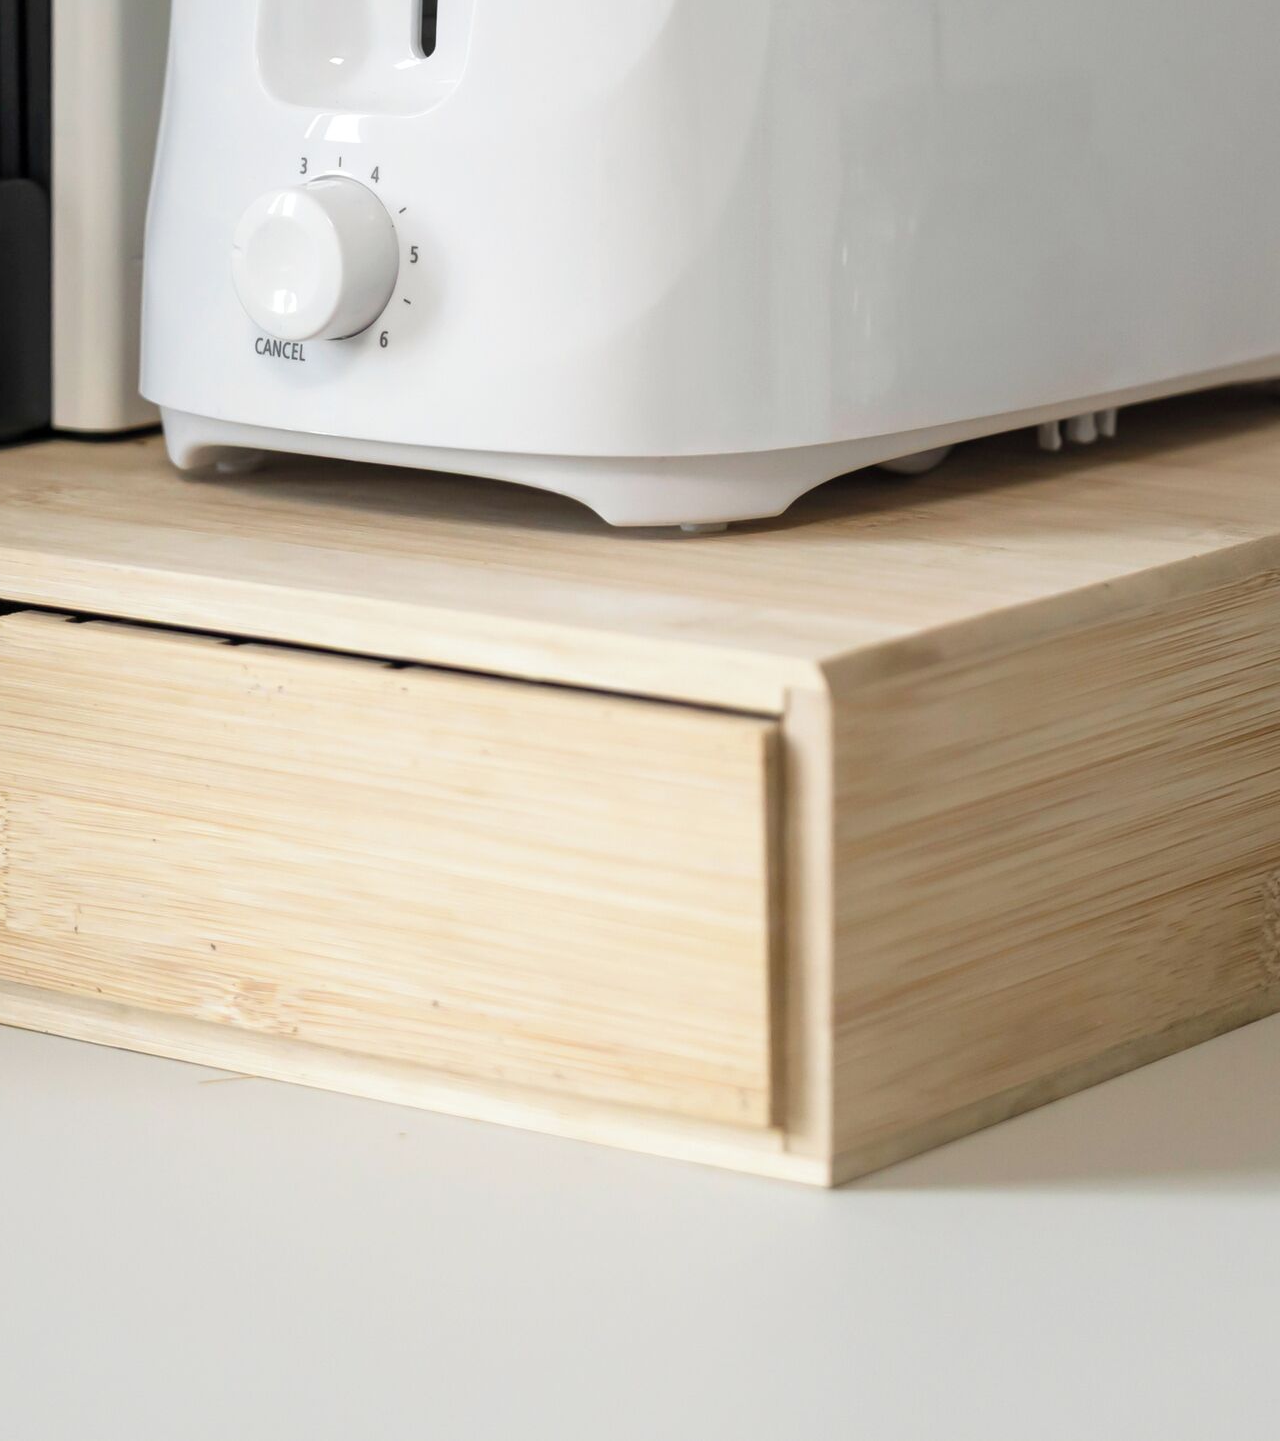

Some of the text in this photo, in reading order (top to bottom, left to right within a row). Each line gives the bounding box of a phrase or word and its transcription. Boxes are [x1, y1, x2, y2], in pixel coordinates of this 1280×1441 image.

[299, 157, 308, 174] 3
[370, 166, 380, 183] 4
[410, 245, 419, 263] 5
[379, 331, 389, 348] 6
[254, 337, 306, 361] CANCEL
